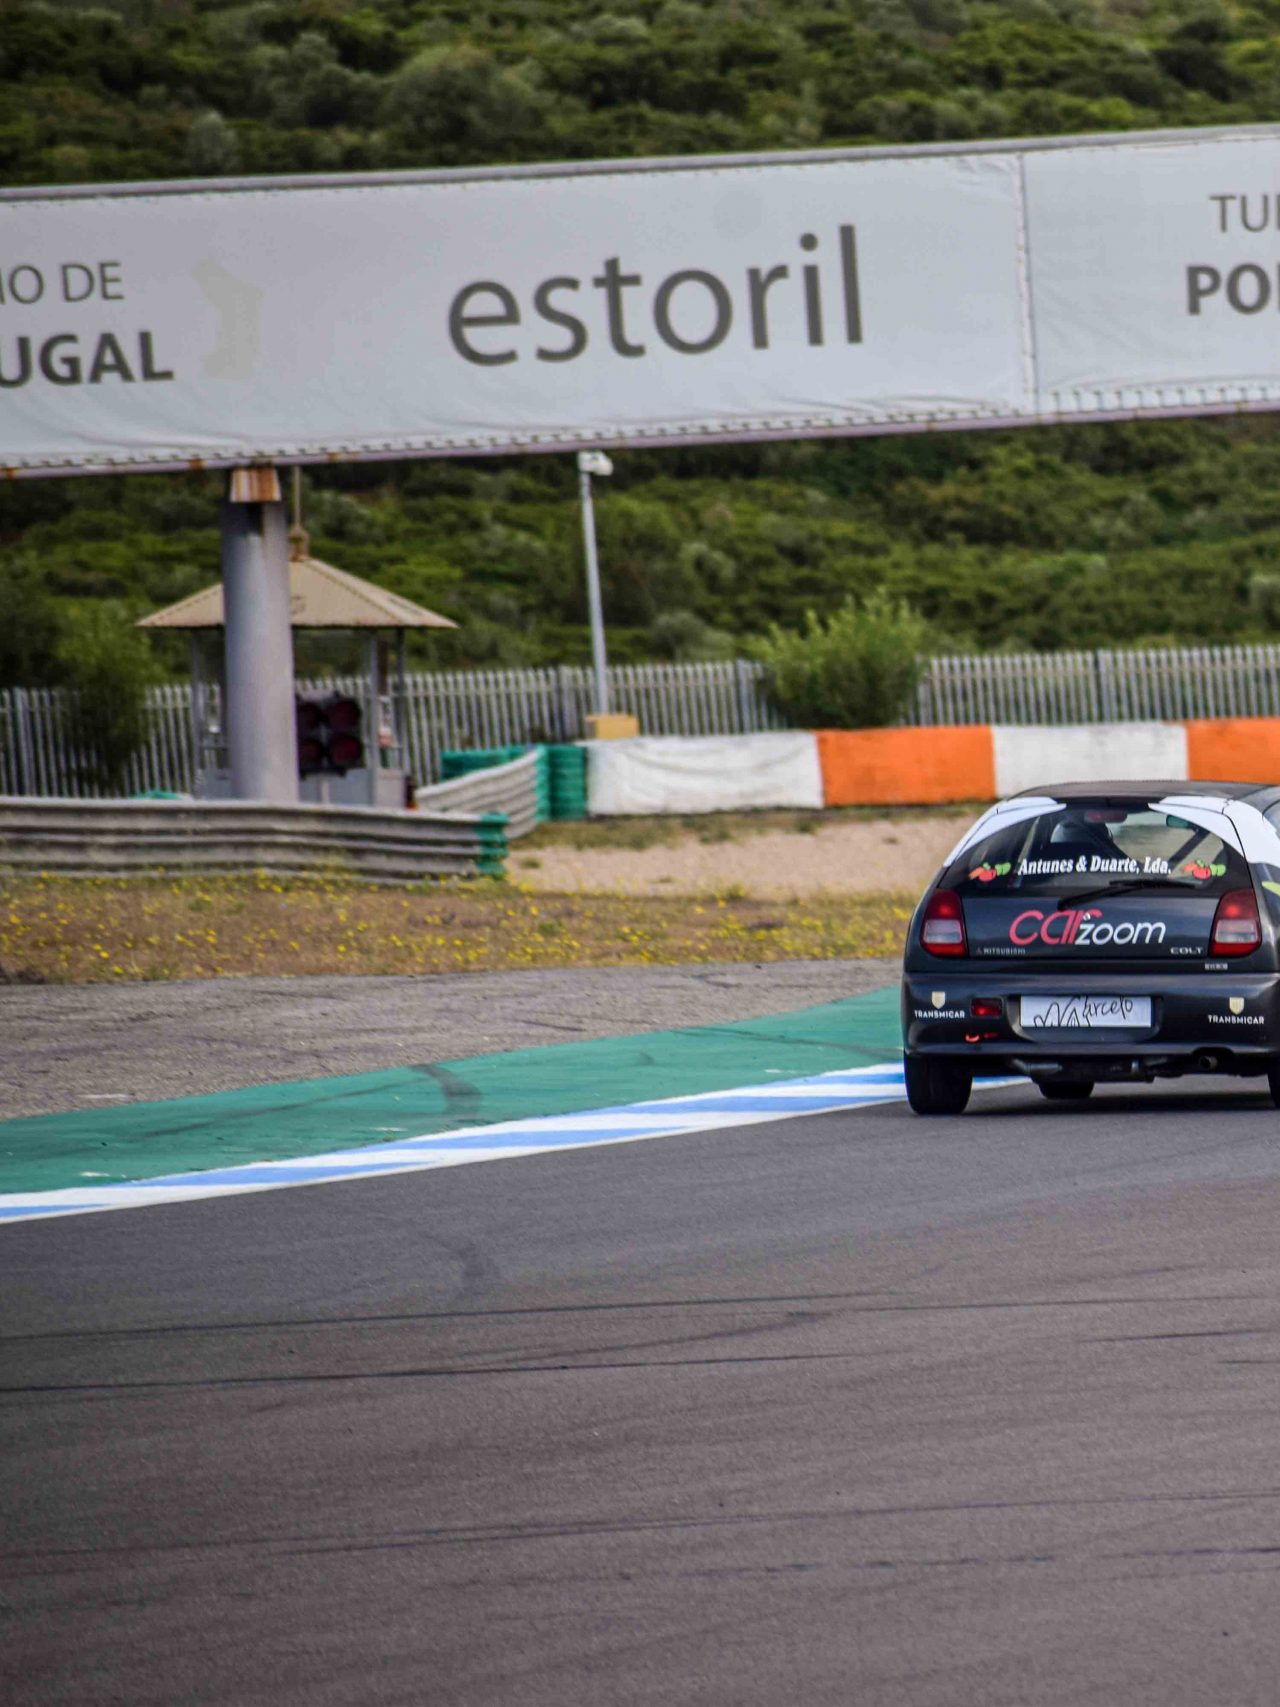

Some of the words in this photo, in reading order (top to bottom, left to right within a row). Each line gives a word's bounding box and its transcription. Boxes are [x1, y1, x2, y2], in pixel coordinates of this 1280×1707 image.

[0, 264, 45, 306] O
[60, 261, 125, 303] DE
[448, 224, 863, 367] estoril
[1017, 858, 1074, 876] Antunes
[1076, 856, 1087, 873] &
[1090, 855, 1140, 874] Duarte,
[1170, 946, 1203, 955] COLT
[914, 1009, 965, 1019] TRANSMICAR
[1207, 1013, 1265, 1025] TRANSMICAR
